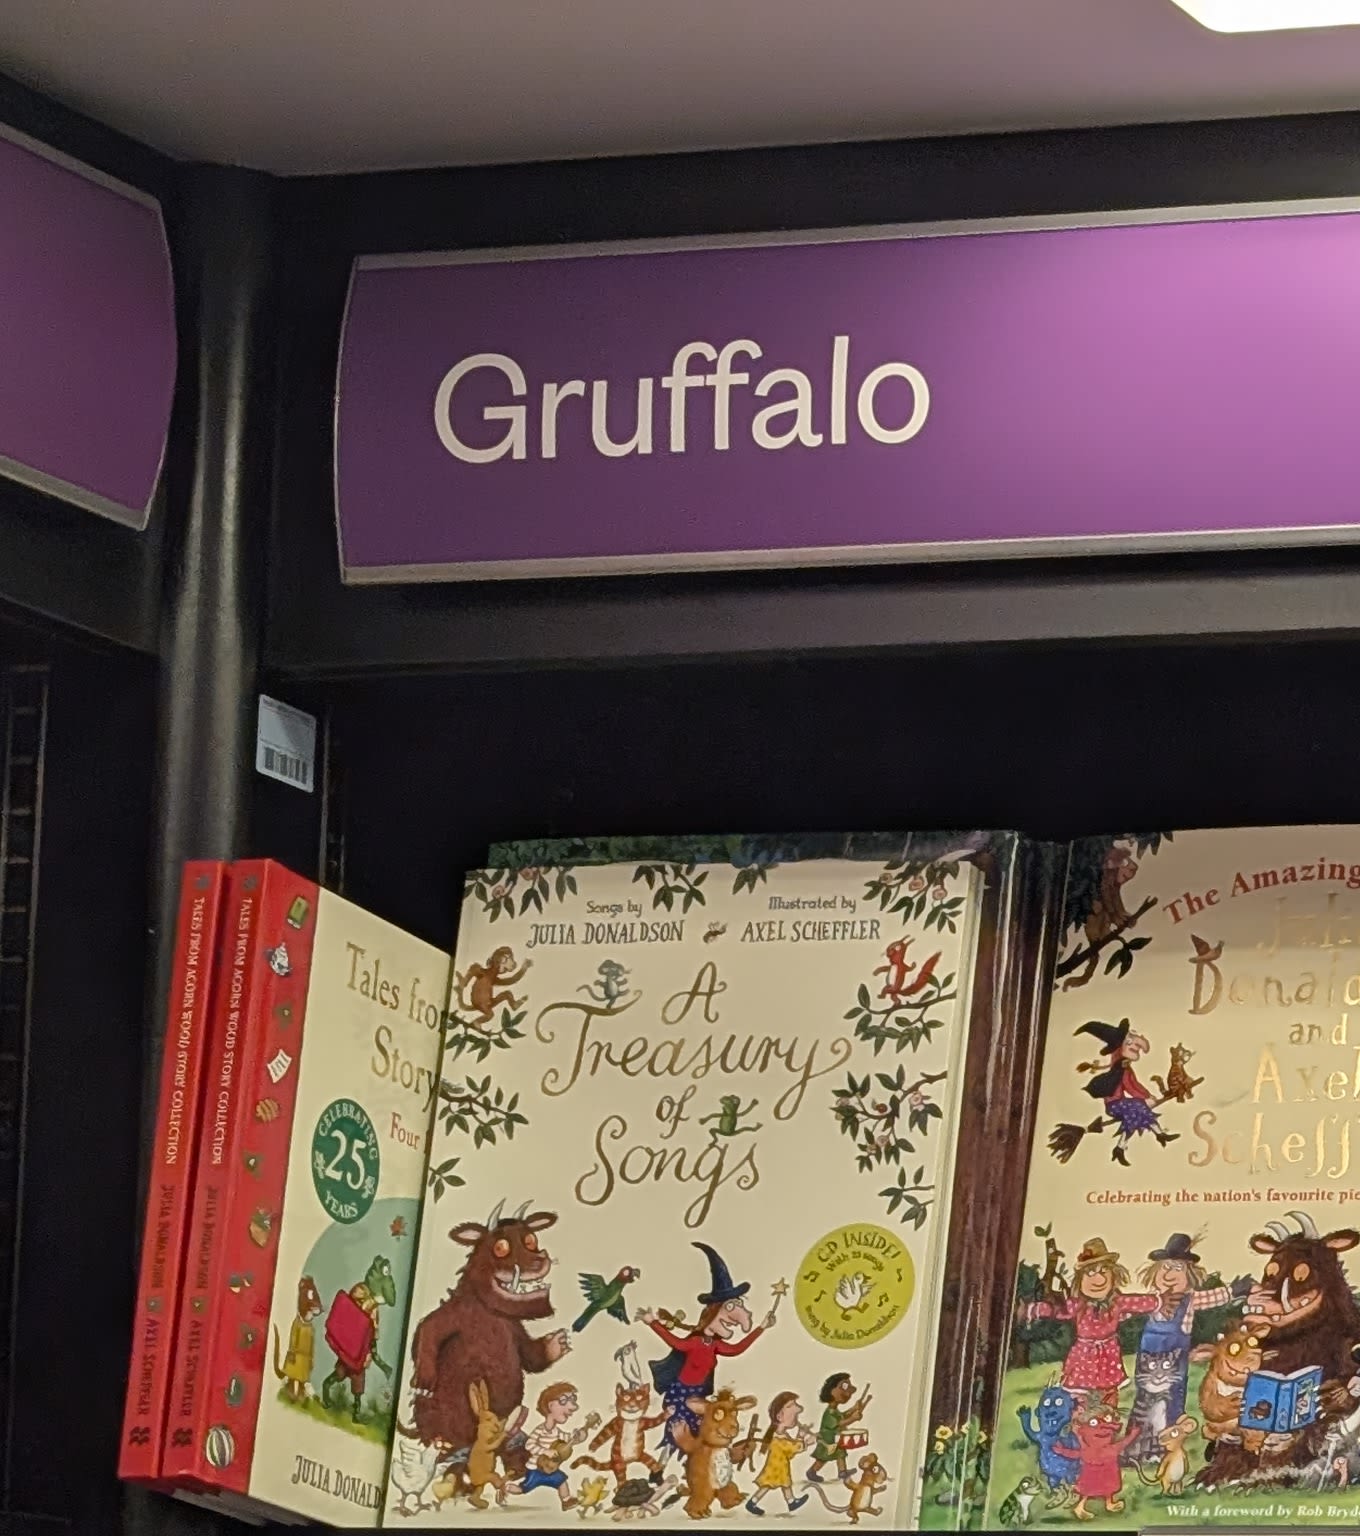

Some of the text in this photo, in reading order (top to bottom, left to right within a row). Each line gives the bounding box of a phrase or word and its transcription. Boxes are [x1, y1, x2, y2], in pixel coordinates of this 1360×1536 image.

[434, 335, 931, 464] Gruffalo
[586, 900, 643, 918] Songs by
[768, 895, 857, 914] Illustrated by
[1162, 884, 1222, 928] The
[525, 920, 685, 949] JULIA DONALDSON
[740, 919, 882, 944] AXEL SCHEFFLER
[346, 941, 401, 1011] Tales
[661, 961, 728, 1025] A
[1288, 1013, 1349, 1050] and
[371, 1024, 439, 1113] Story
[535, 988, 853, 1122] Treasury
[165, 1090, 184, 1165] COLLECTION
[211, 1091, 230, 1165] COLLECTION
[318, 1102, 378, 1161] CELEBRATING
[390, 1111, 420, 1151] Four
[655, 1084, 698, 1139] of
[325, 1129, 368, 1191] 25
[574, 1114, 760, 1228] Songs
[324, 1189, 359, 1219] YEARS
[1085, 1188, 1172, 1208] Celebrating
[1174, 1187, 1200, 1203] the
[1203, 1187, 1263, 1203] nation's
[1266, 1186, 1336, 1203] favourite
[818, 1230, 902, 1263] CD INSIDE!
[291, 1454, 331, 1495] JULIA
[1166, 1504, 1199, 1518] With
[1201, 1507, 1211, 1518] a
[1213, 1504, 1274, 1518] foreword
[1276, 1504, 1293, 1520] by
[1297, 1504, 1324, 1518] Rob
